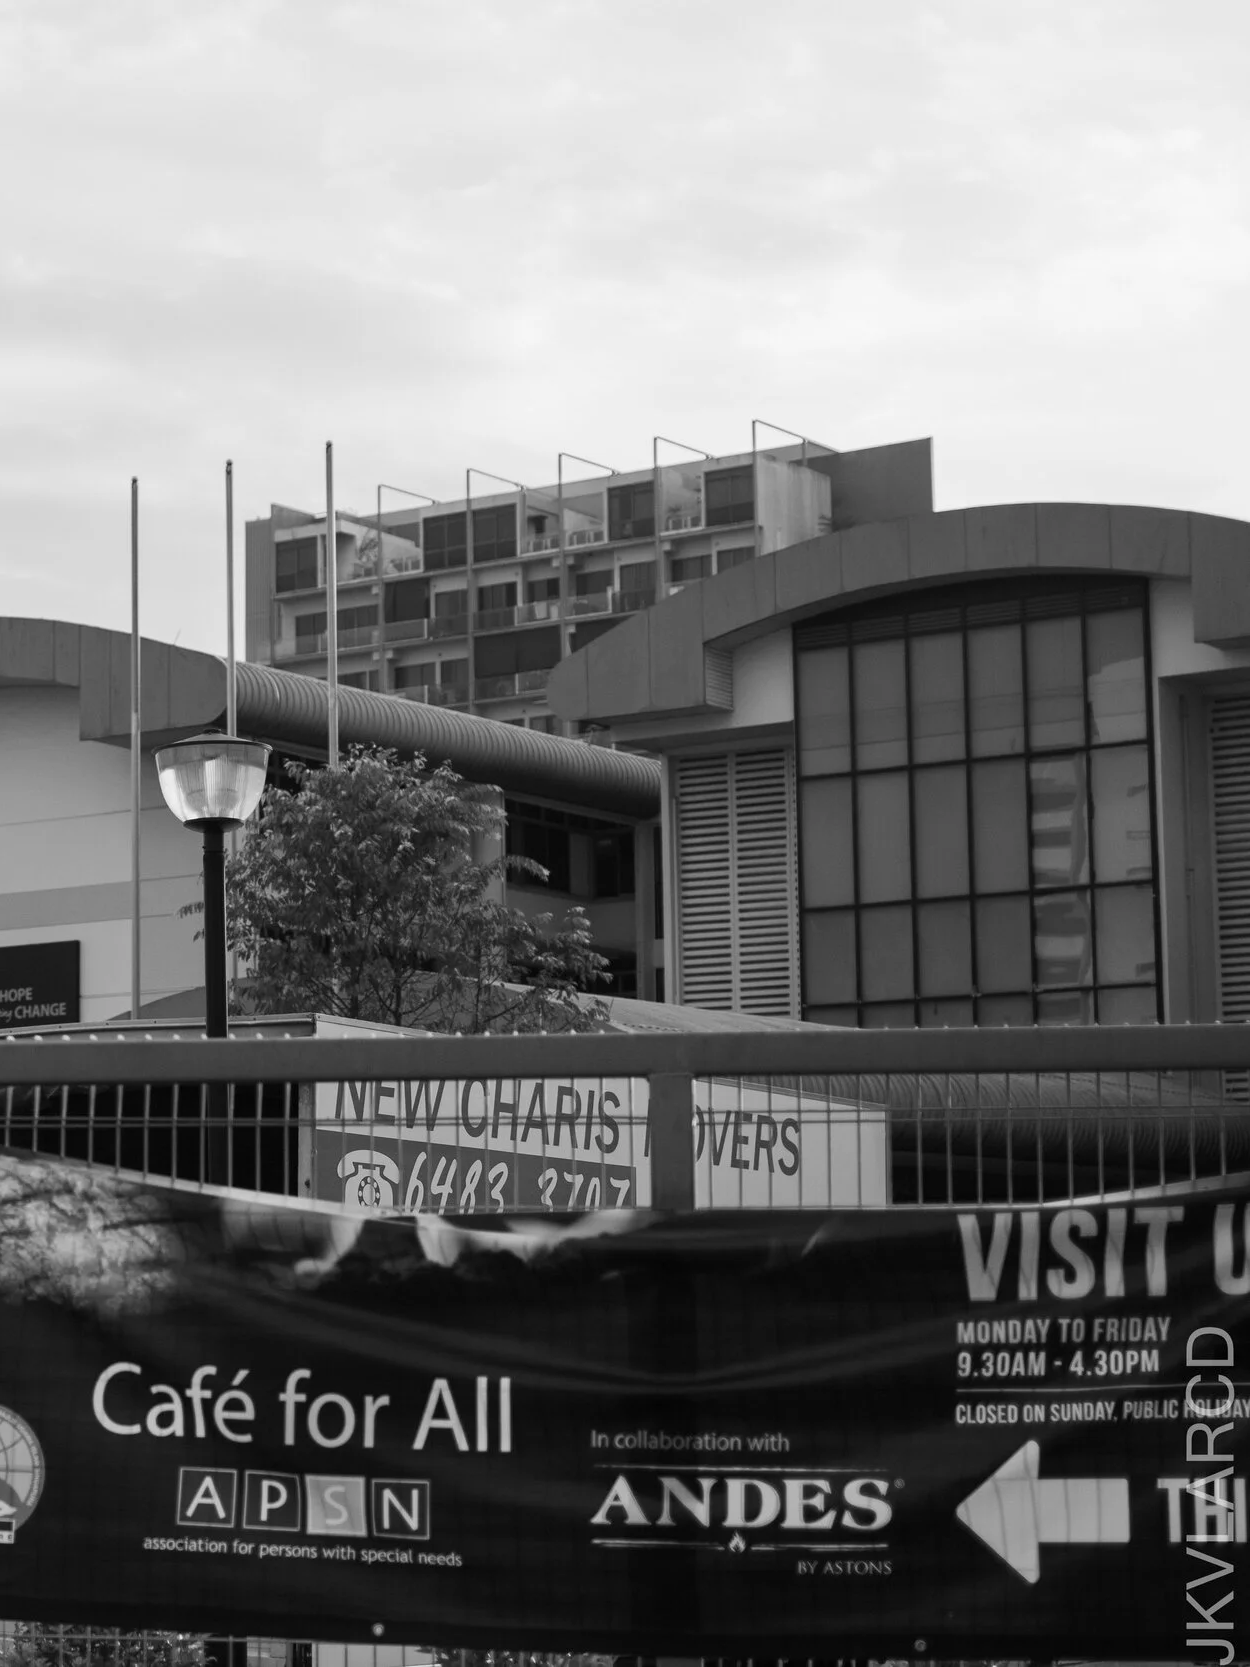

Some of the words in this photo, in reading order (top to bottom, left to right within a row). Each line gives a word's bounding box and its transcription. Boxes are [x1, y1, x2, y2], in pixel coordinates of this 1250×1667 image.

[0, 987, 33, 1003] HOPE
[14, 1002, 67, 1019] CHANGE
[335, 1079, 446, 1132] NEW
[461, 1079, 621, 1154] CHARIS
[957, 1206, 1184, 1301] VISIT
[957, 1318, 1050, 1344] MONDAY
[1058, 1318, 1086, 1343] TO
[1093, 1316, 1171, 1342] FRIDAY
[958, 1351, 1046, 1377] 9.30AM
[1069, 1349, 1159, 1375] 4.30PM
[92, 1361, 256, 1444] Café
[278, 1369, 390, 1449] for
[411, 1375, 512, 1453] All
[956, 1404, 1018, 1424] CLOSED
[1023, 1403, 1045, 1423] ON
[1050, 1402, 1118, 1422] SUNDAY,
[1123, 1400, 1178, 1420] PUBLIC
[590, 1429, 609, 1449] In
[614, 1429, 742, 1452] collaboration
[746, 1432, 790, 1452] with
[143, 1536, 227, 1555] association
[233, 1538, 254, 1556] for
[259, 1542, 317, 1560] persons
[322, 1544, 356, 1561] with
[361, 1546, 413, 1567] special
[418, 1551, 462, 1568] needs
[798, 1561, 818, 1575] BY
[823, 1560, 892, 1576] ASTONS
